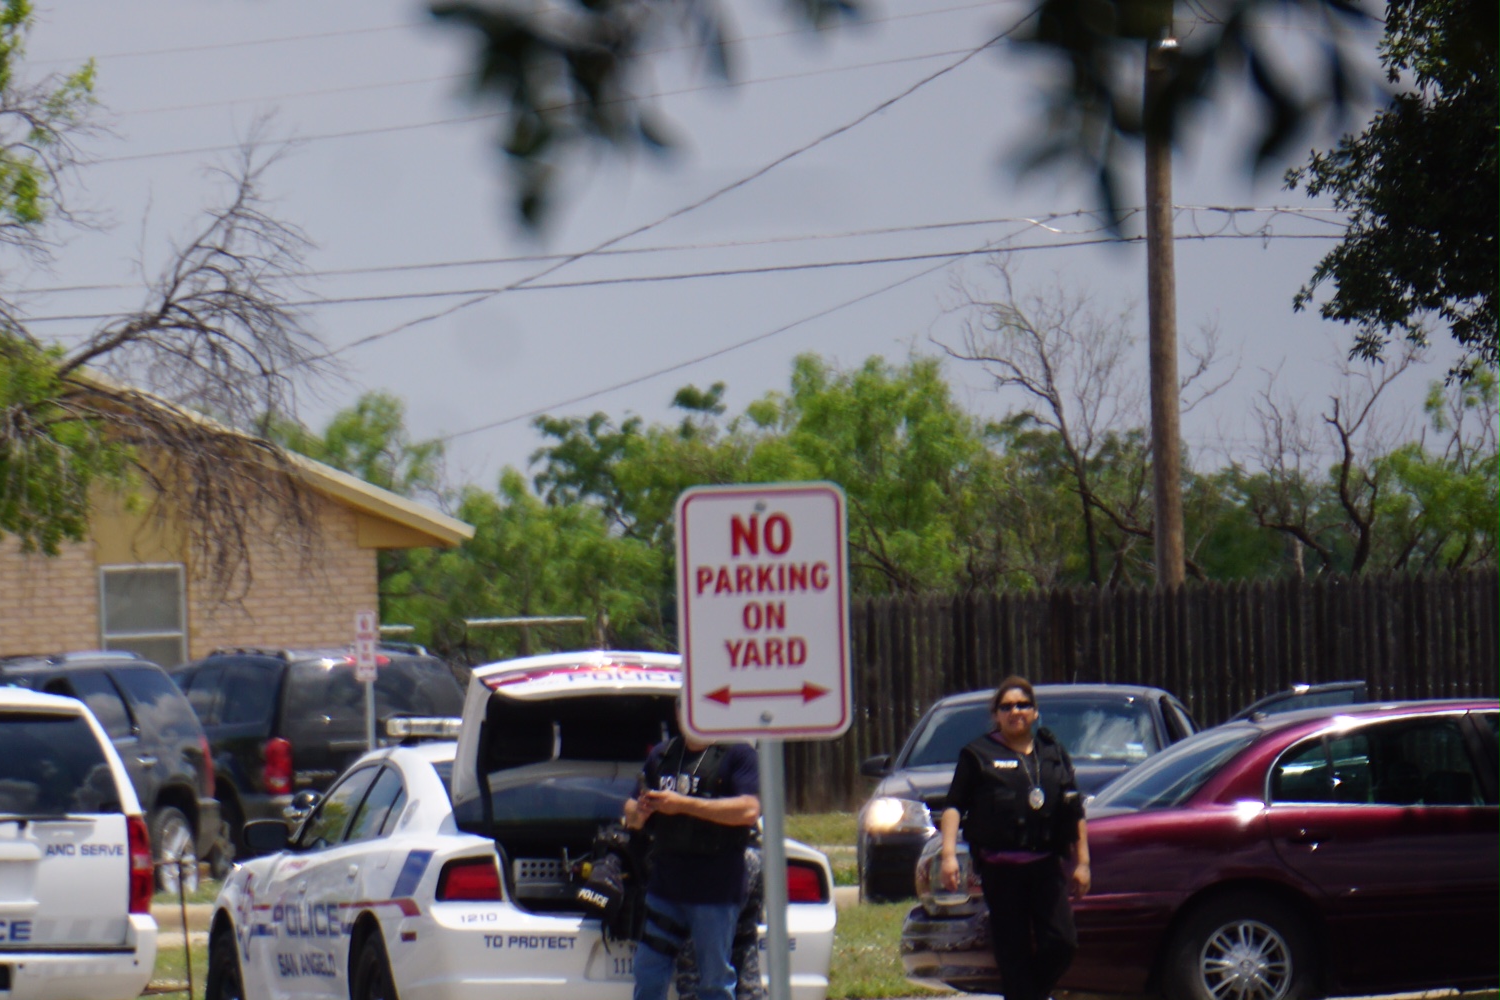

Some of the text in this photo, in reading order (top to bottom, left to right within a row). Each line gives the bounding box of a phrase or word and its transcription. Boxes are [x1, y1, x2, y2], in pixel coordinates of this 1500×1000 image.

[730, 511, 792, 556] NO
[696, 562, 830, 594] PARKING
[743, 601, 786, 630] ON
[724, 638, 807, 667] YARD
[45, 844, 125, 857] AND SERVE
[578, 888, 609, 909] POLICE
[273, 903, 341, 937] POLICE
[485, 935, 577, 949] TO PROTECT
[277, 952, 337, 977] SAN ANGELO
